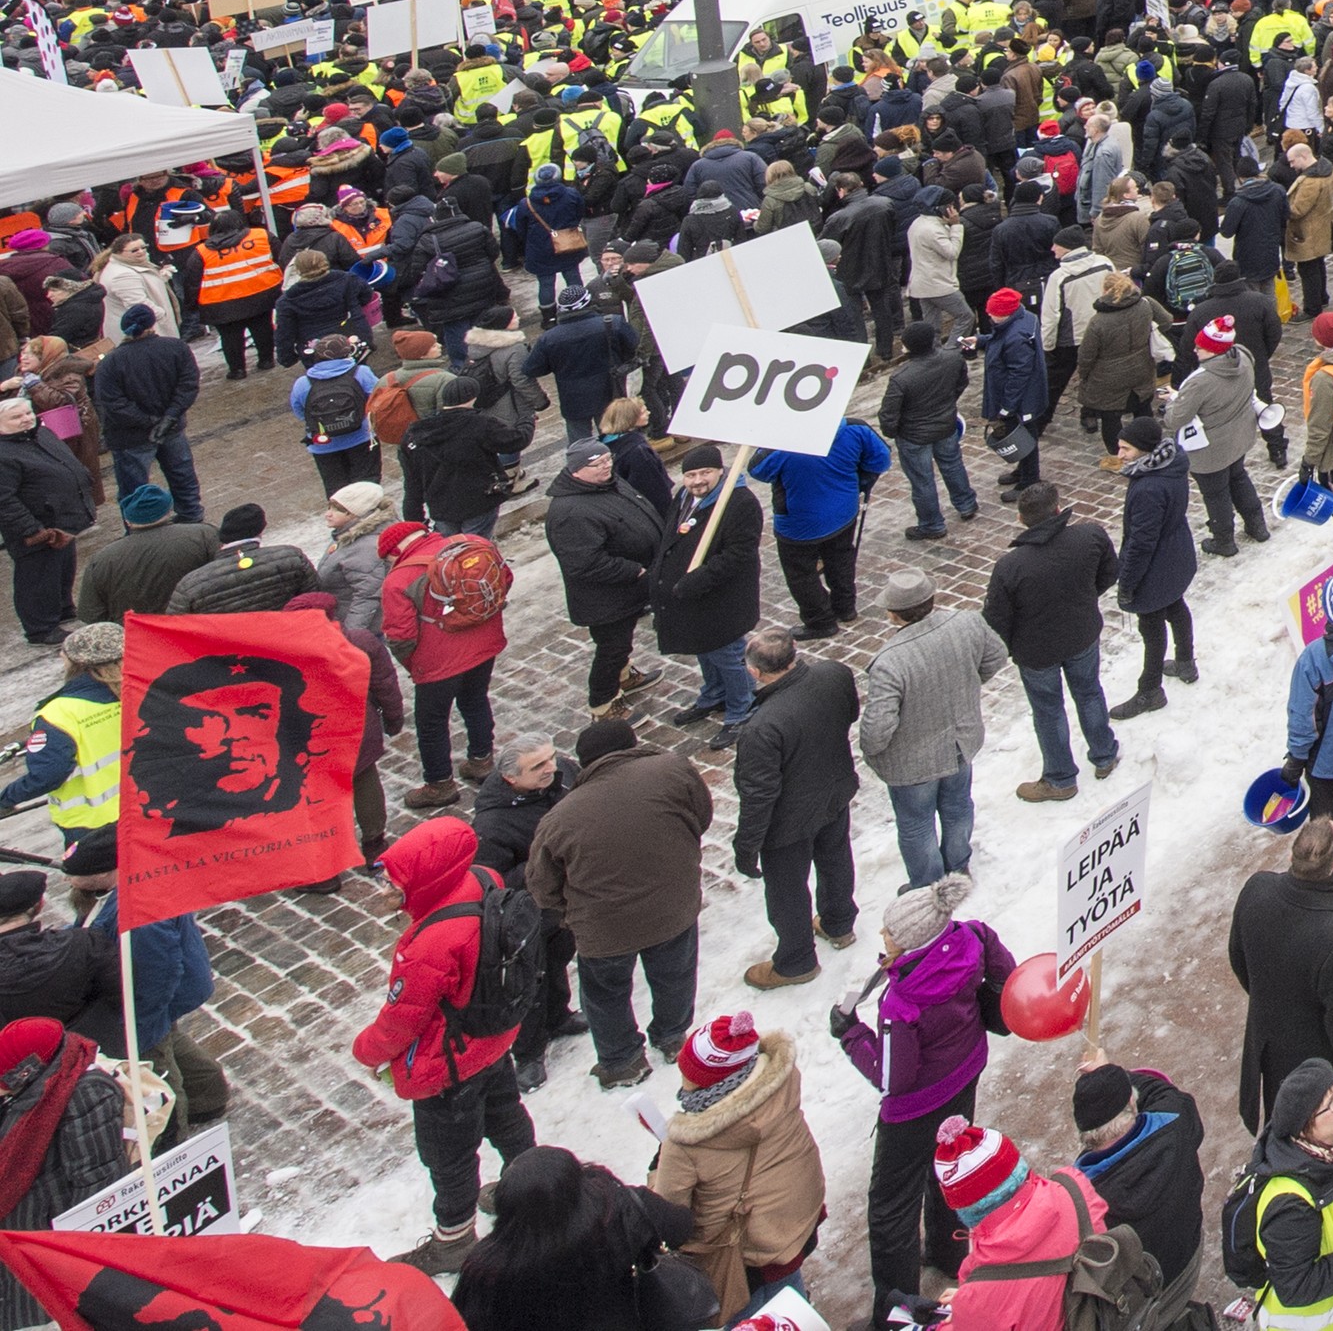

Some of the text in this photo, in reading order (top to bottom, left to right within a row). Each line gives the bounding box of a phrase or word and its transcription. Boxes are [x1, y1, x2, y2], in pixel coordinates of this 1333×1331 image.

[217, 240, 254, 260] pro
[700, 351, 840, 413] pro
[126, 835, 292, 885] HASTA LA VICTORIA
[1066, 813, 1141, 894] LEIPÄÄ
[1087, 865, 1115, 901] JA
[1066, 879, 1136, 948] TYÖTÄ
